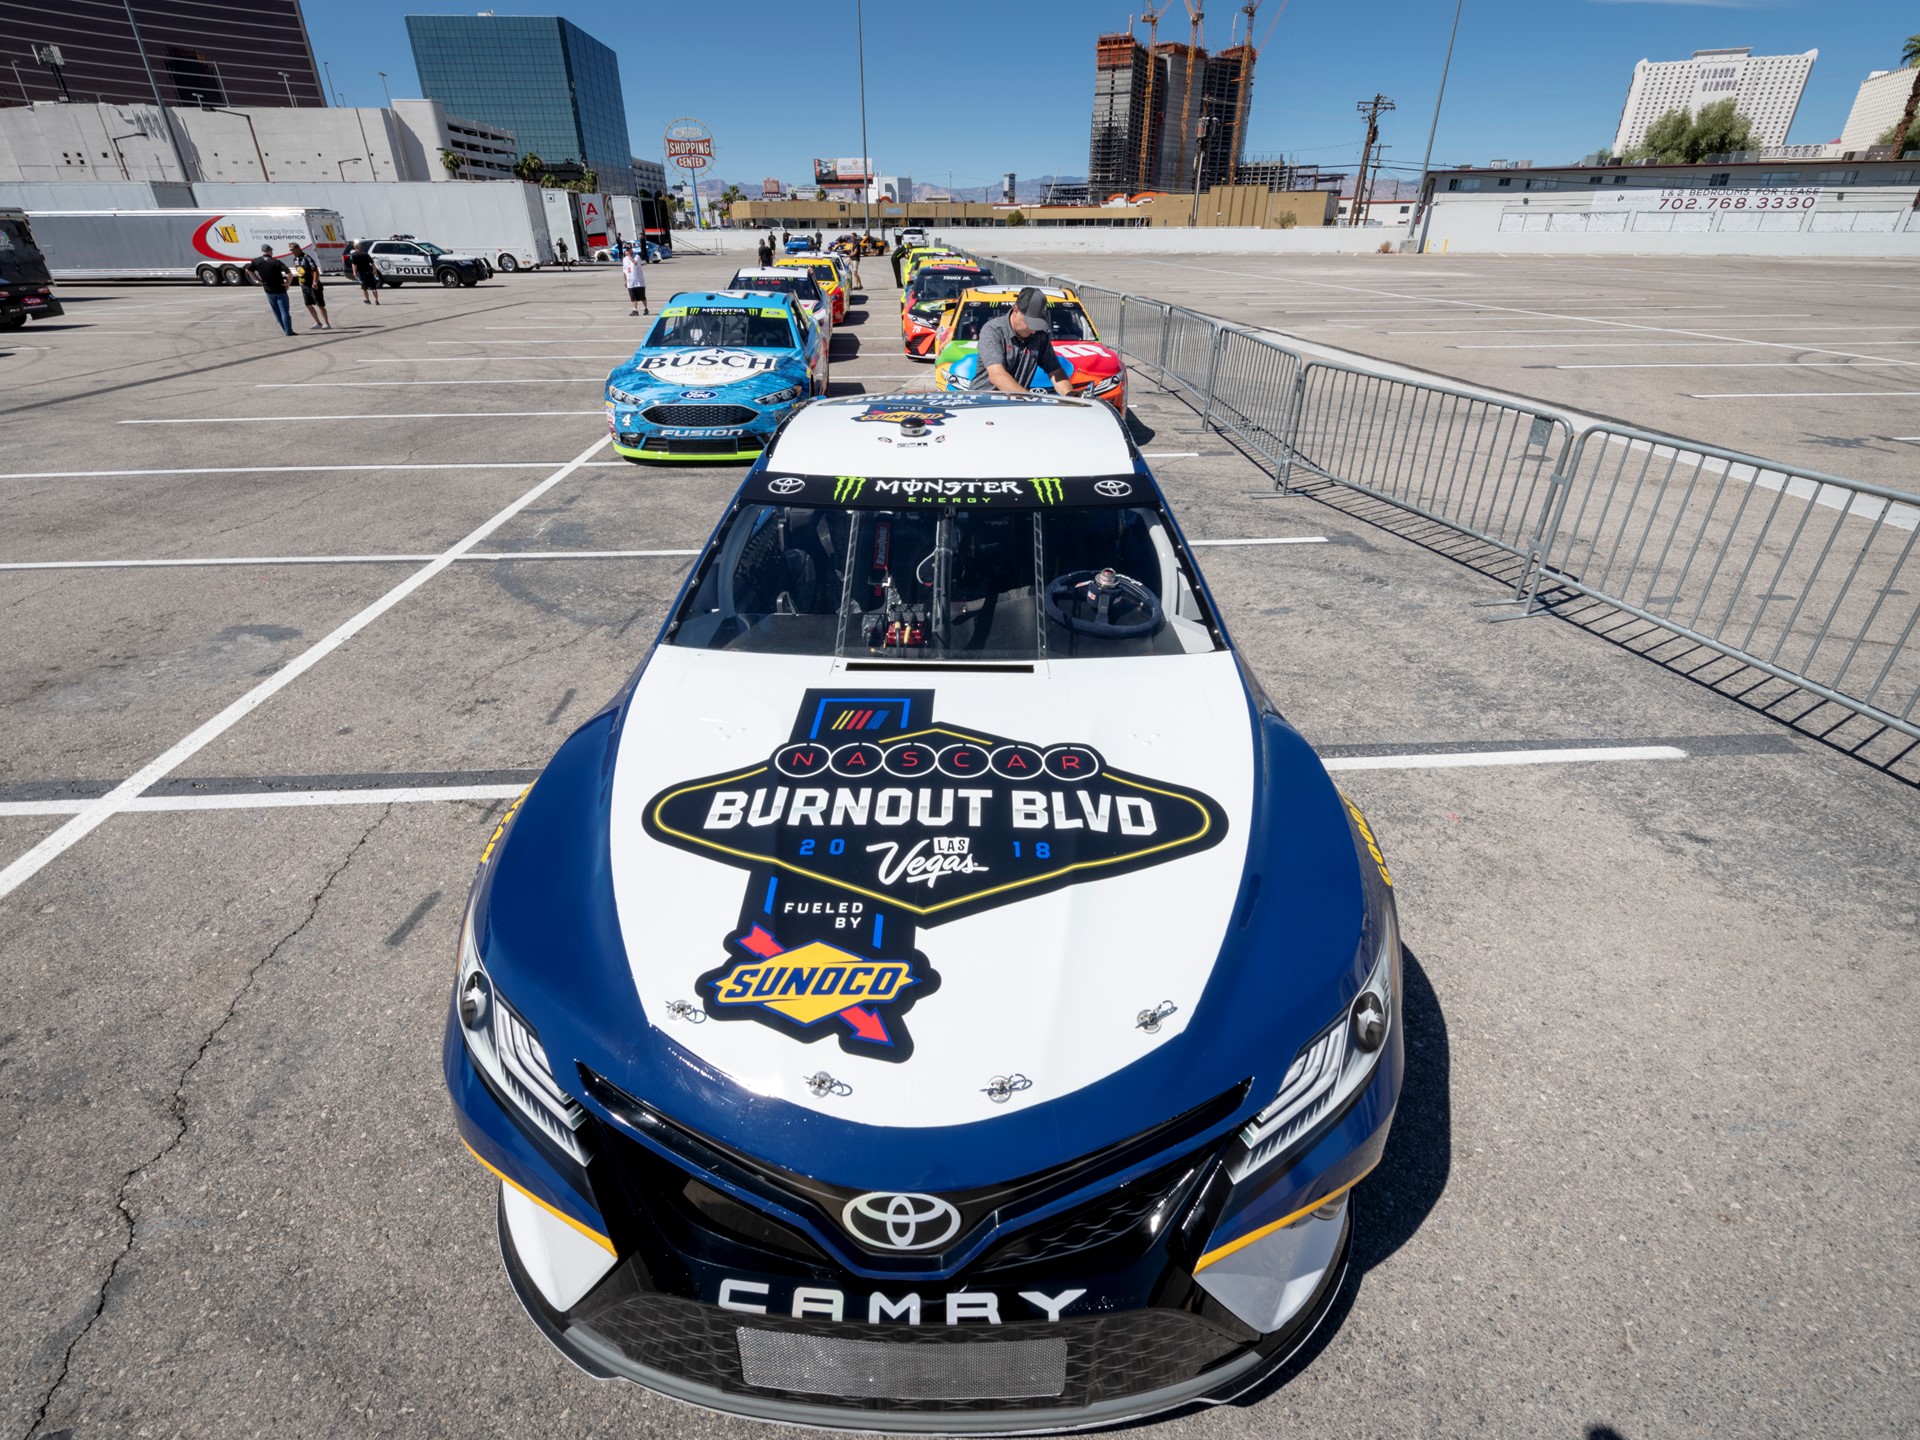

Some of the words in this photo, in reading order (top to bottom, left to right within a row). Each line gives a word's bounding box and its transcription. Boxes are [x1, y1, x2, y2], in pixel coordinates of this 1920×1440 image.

[669, 142, 710, 154] SHOPPING
[678, 157, 704, 168] CENTER
[1689, 188, 1750, 196] BEDROOMS
[1783, 187, 1820, 195] LEASE
[1659, 197, 1816, 210] 702.768.3330
[249, 228, 280, 236] Extending
[396, 267, 433, 275] POLICE
[641, 355, 776, 370] BUSCH
[686, 390, 711, 398] Ford
[622, 414, 631, 426] 4
[660, 429, 744, 437] FUSION
[874, 479, 1024, 496] MONSTER
[792, 751, 1081, 771] NASCAR
[703, 787, 993, 830] BURNOUT
[1012, 789, 1159, 837] BLVD
[936, 838, 967, 854] LAS
[866, 840, 989, 887] Vegas
[783, 902, 863, 916] FUELED
[836, 917, 862, 929] BY
[731, 965, 902, 998] SUNOCO
[718, 1278, 1087, 1325] CAMRY
